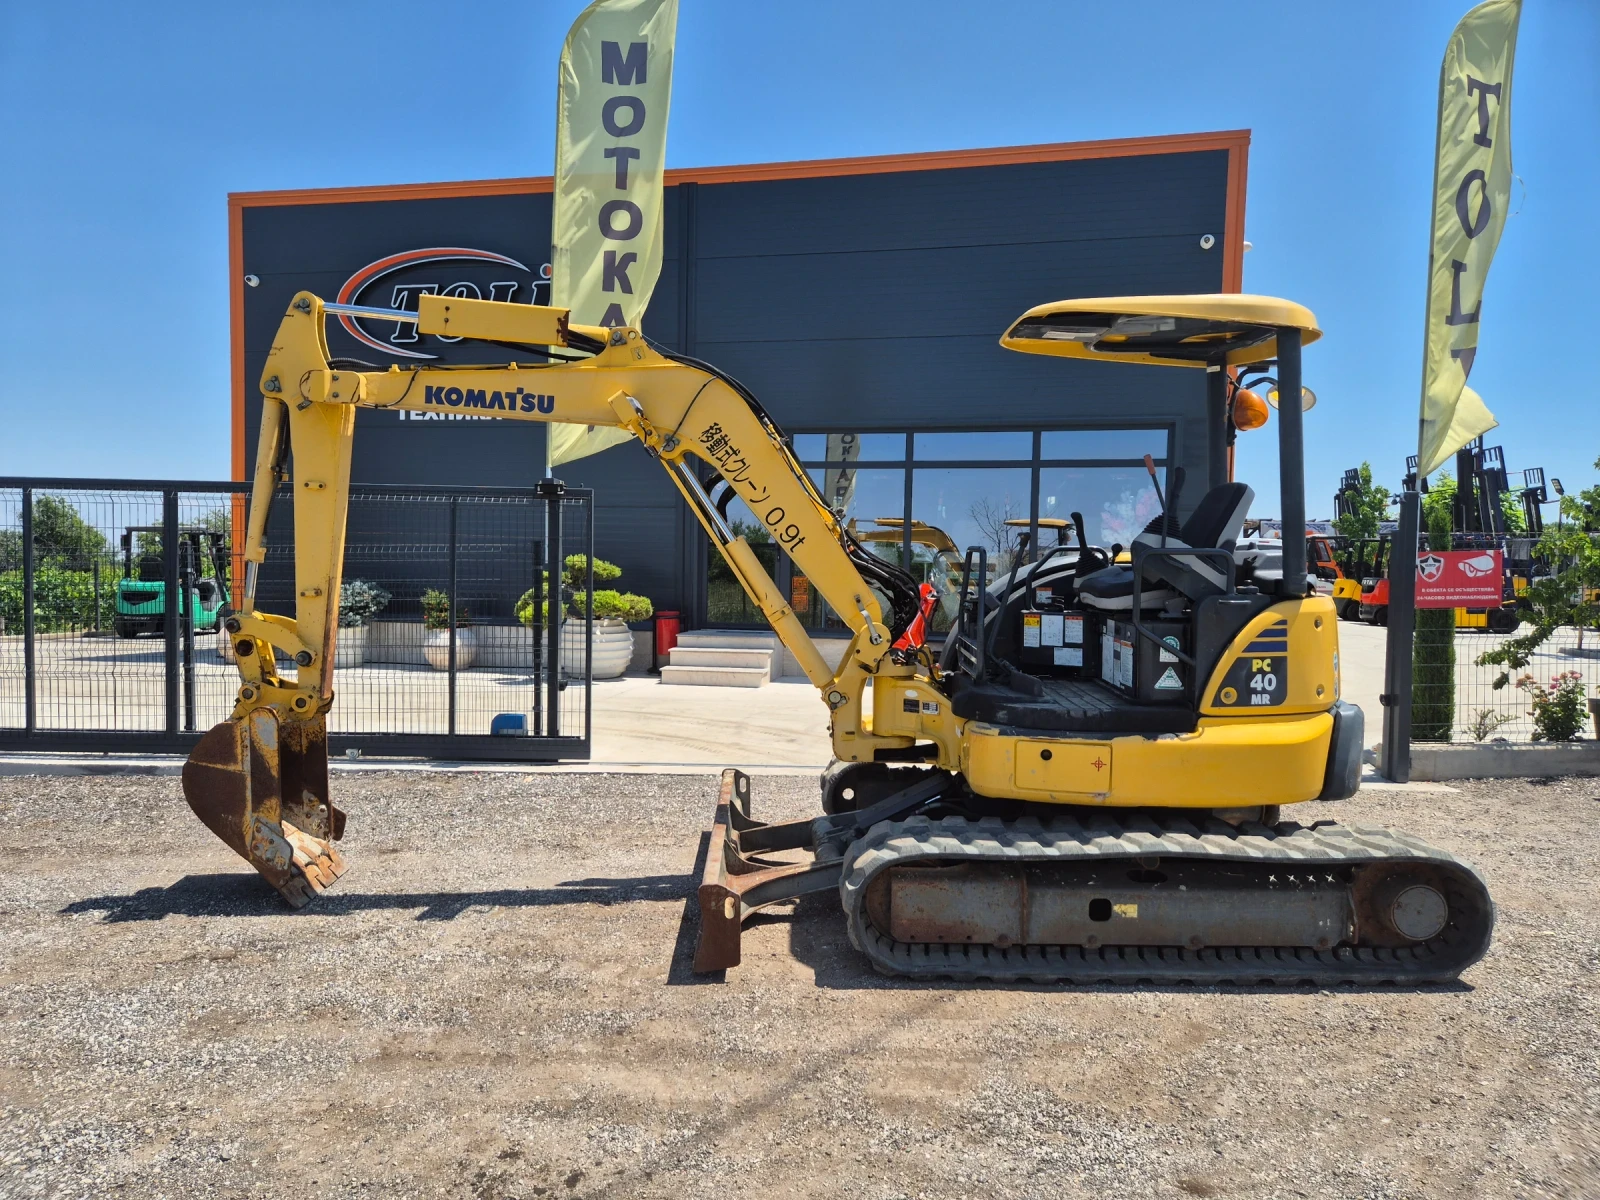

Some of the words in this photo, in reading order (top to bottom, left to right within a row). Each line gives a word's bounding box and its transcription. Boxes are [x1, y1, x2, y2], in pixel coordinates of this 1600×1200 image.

[425, 385, 555, 414] KOMATSU
[698, 421, 771, 504] 移動式クレーン
[765, 506, 807, 554] 0.9t
[1252, 658, 1272, 672] PC
[1250, 673, 1277, 691] 40
[1250, 694, 1271, 705] MR
